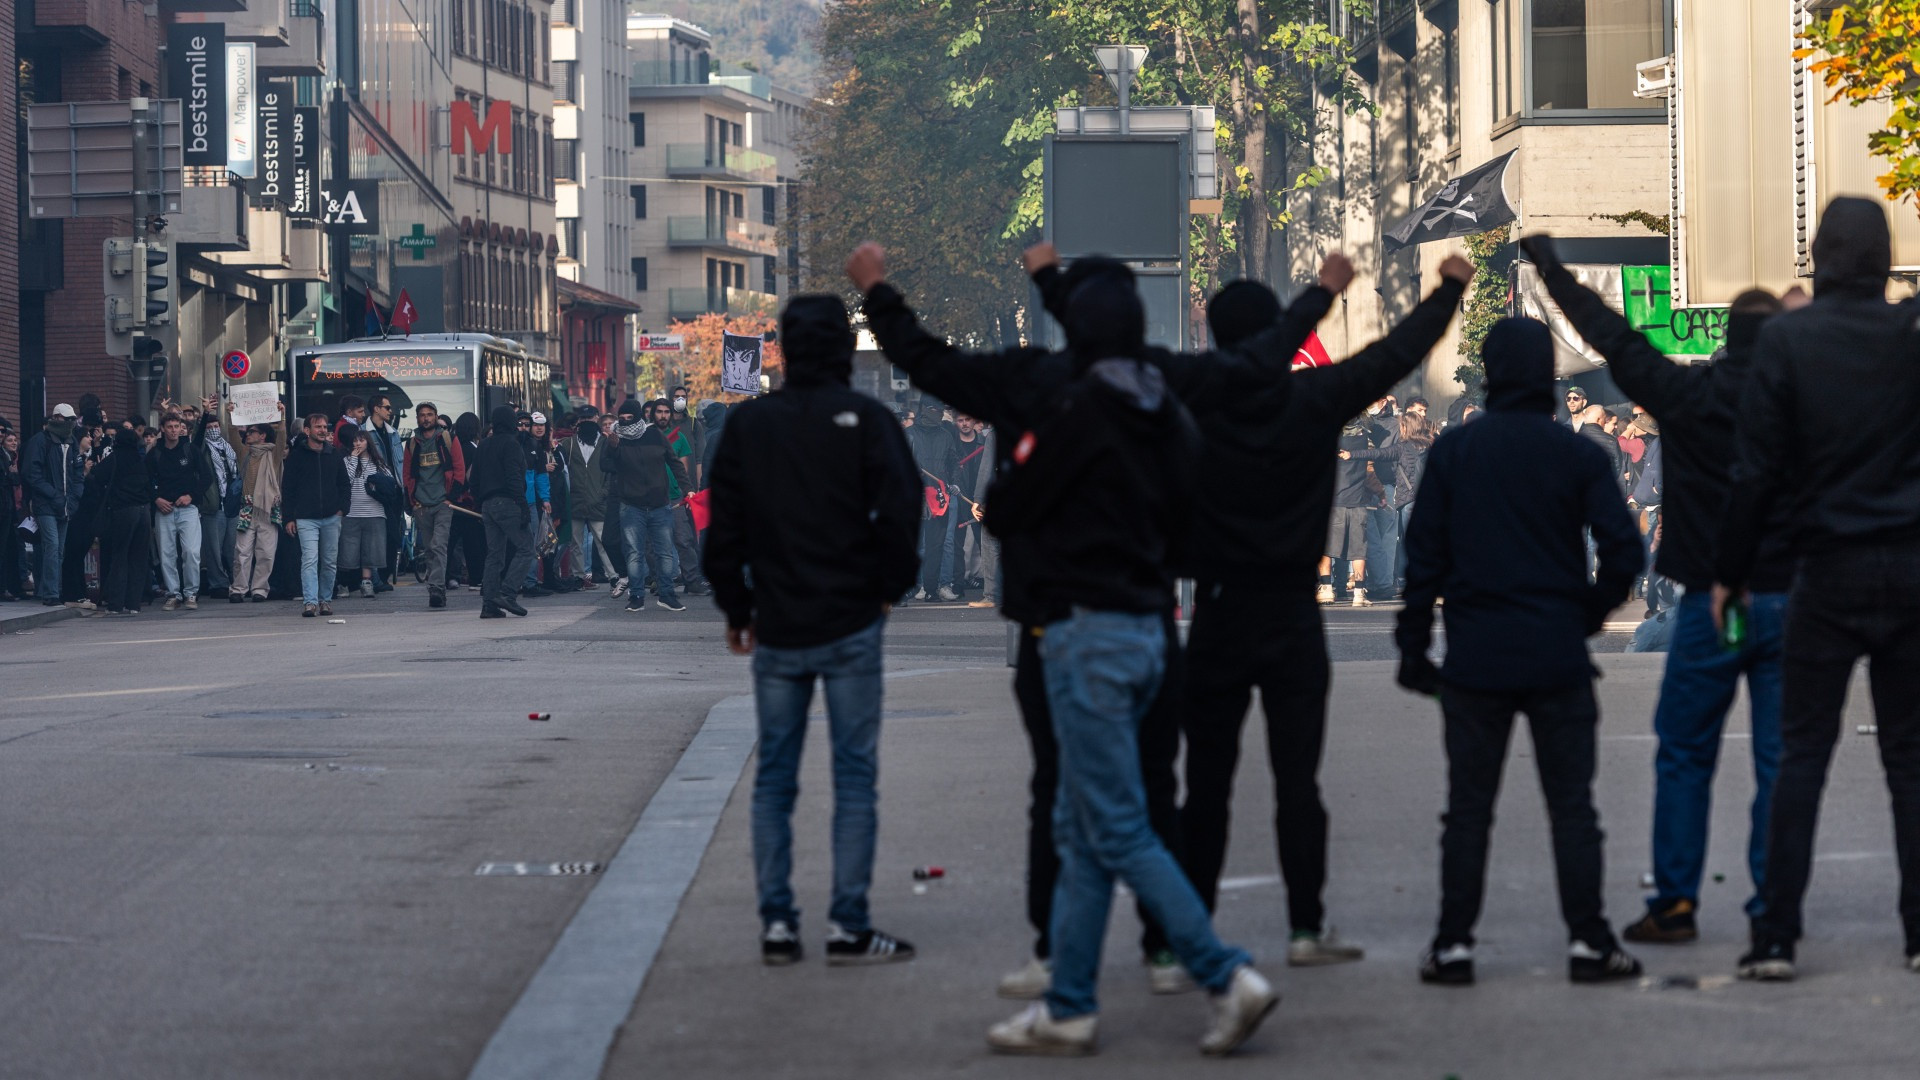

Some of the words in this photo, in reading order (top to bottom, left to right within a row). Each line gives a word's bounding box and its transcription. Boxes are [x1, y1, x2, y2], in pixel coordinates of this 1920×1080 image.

[186, 36, 207, 152] bestsmile
[234, 52, 248, 125] Manpower
[260, 92, 279, 195] bestsmile
[451, 100, 512, 154] M
[311, 359, 322, 381] 7
[325, 368, 344, 379] via
[348, 367, 386, 378] Stadio
[392, 365, 458, 377] Cornaredo
[349, 355, 434, 368] PREGASSONA
